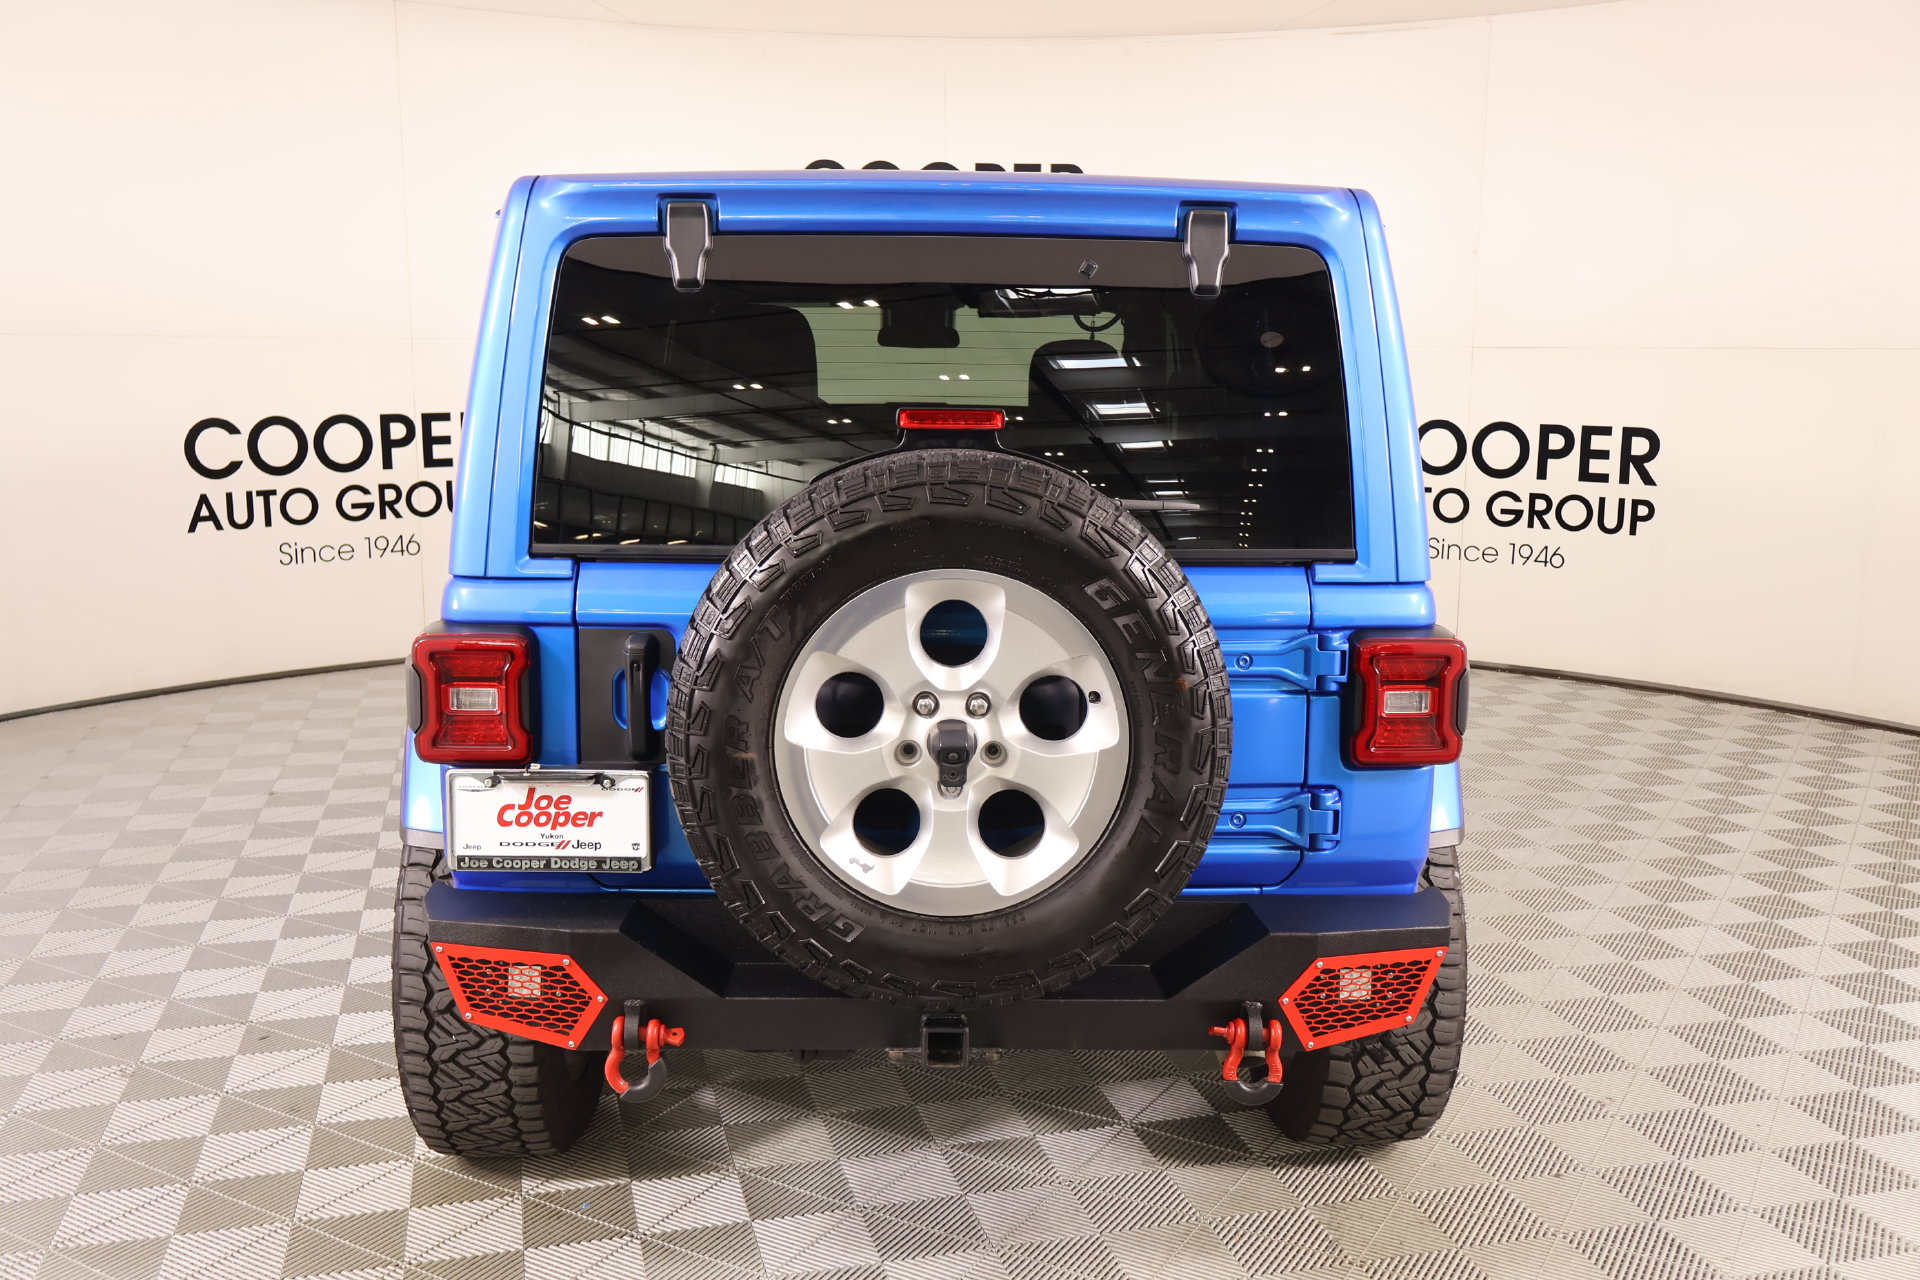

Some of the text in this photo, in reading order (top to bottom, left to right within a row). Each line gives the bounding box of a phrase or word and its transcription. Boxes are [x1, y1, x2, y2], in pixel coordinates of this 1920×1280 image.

[184, 412, 464, 480] COOPE
[187, 480, 454, 533] AUTO GRO
[1485, 490, 1656, 536] GROUP
[279, 533, 421, 566] Since 1946
[1428, 537, 1565, 569] Since 1946
[1082, 576, 1188, 846] GENERAL
[517, 786, 573, 811] Joe
[496, 803, 604, 831] Cooper
[723, 714, 865, 943] GRABBER
[462, 843, 482, 851] Jeep
[540, 832, 564, 840] Yukon
[571, 839, 602, 851] Jeep
[460, 856, 639, 871] Joe Cooper Dodge Jeep
